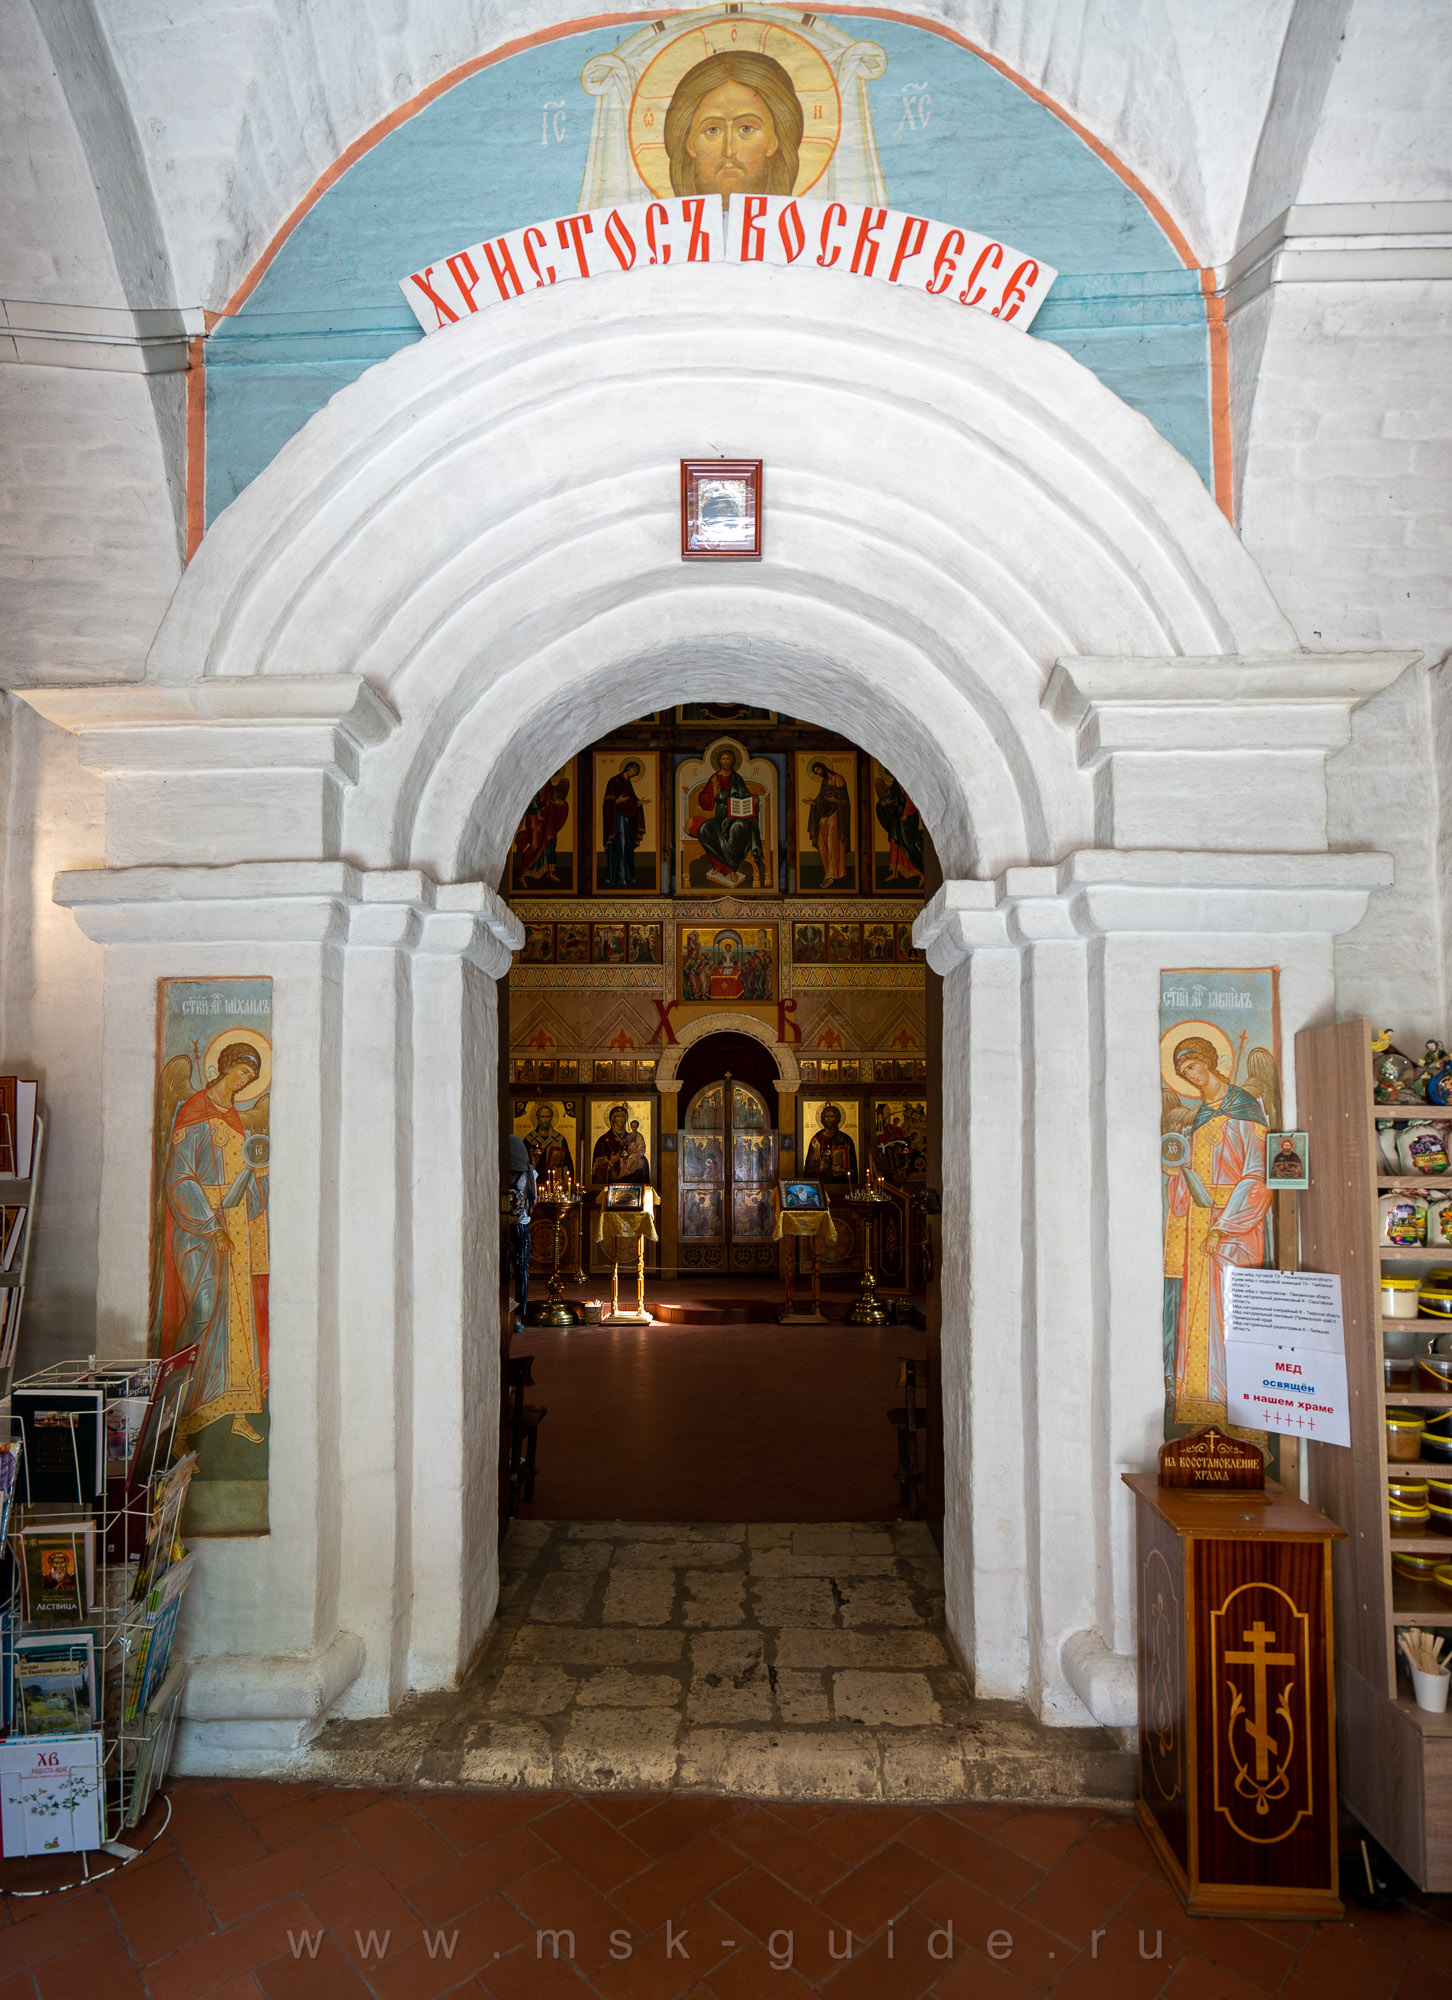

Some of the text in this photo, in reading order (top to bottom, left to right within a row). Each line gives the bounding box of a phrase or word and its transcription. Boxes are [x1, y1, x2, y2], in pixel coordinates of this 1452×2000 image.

[1275, 1362, 1303, 1375] МЕД
[1262, 1379, 1315, 1394] освящён
[1253, 1394, 1294, 1407] нашем
[1297, 1401, 1334, 1414] храме
[1164, 1456, 1259, 1469] НА ВОССТАНОВЛЕНИЕ
[1195, 1470, 1230, 1481] ХРАМА
[36, 1603, 78, 1611] ЛЕСТВИЦА
